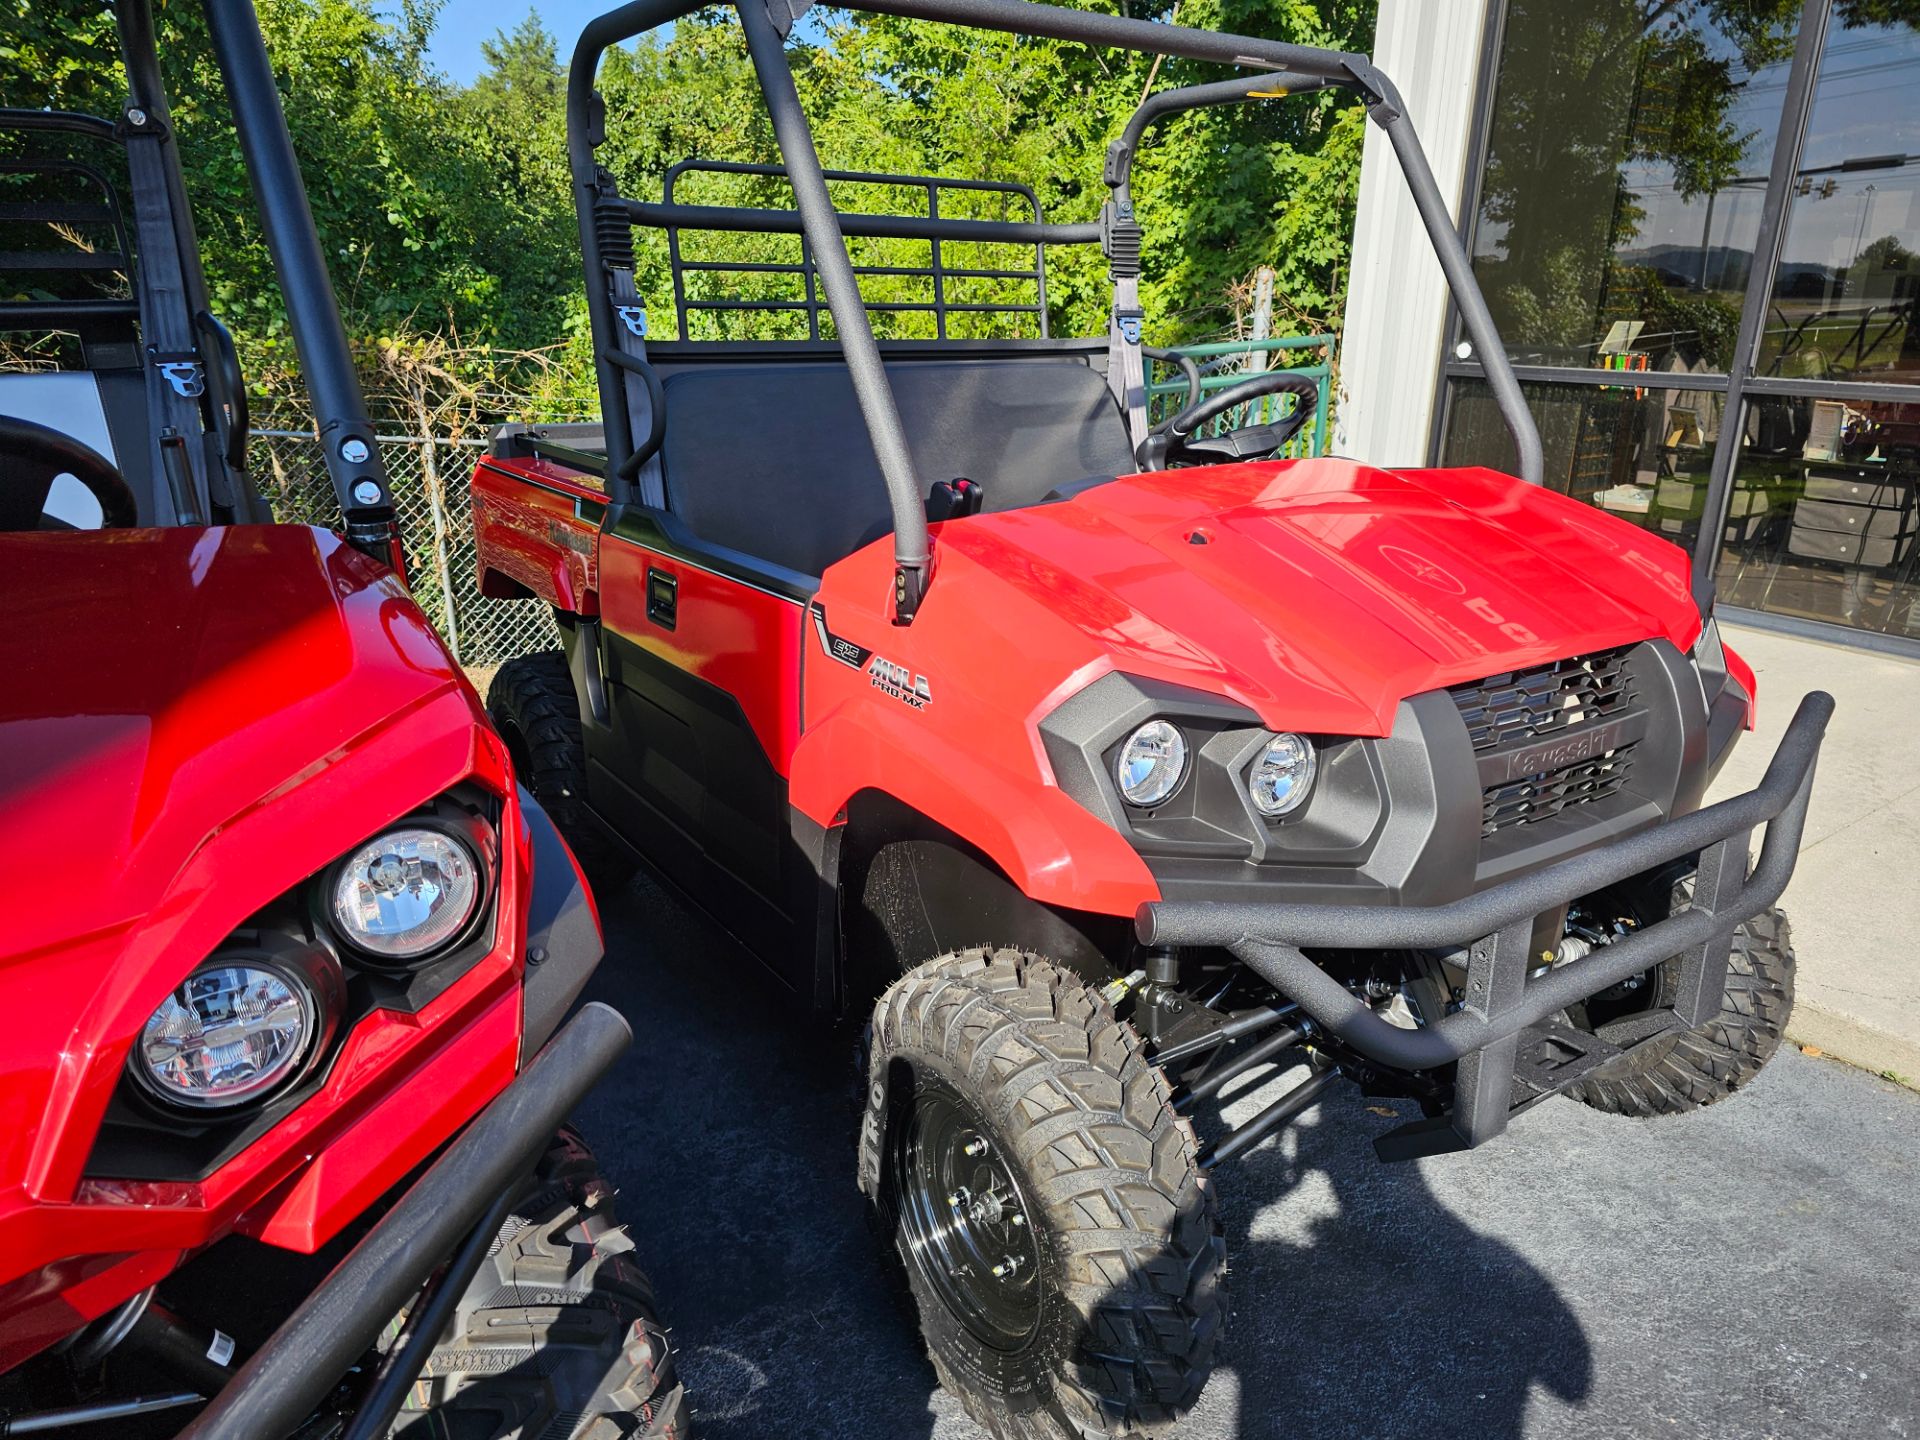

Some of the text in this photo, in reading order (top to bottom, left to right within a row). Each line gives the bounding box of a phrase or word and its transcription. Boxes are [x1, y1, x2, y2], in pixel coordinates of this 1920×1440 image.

[834, 639, 859, 658] EPS
[868, 656, 932, 703] MULE
[872, 679, 924, 711] PRO-MX
[1507, 726, 1608, 780] Kawasaki
